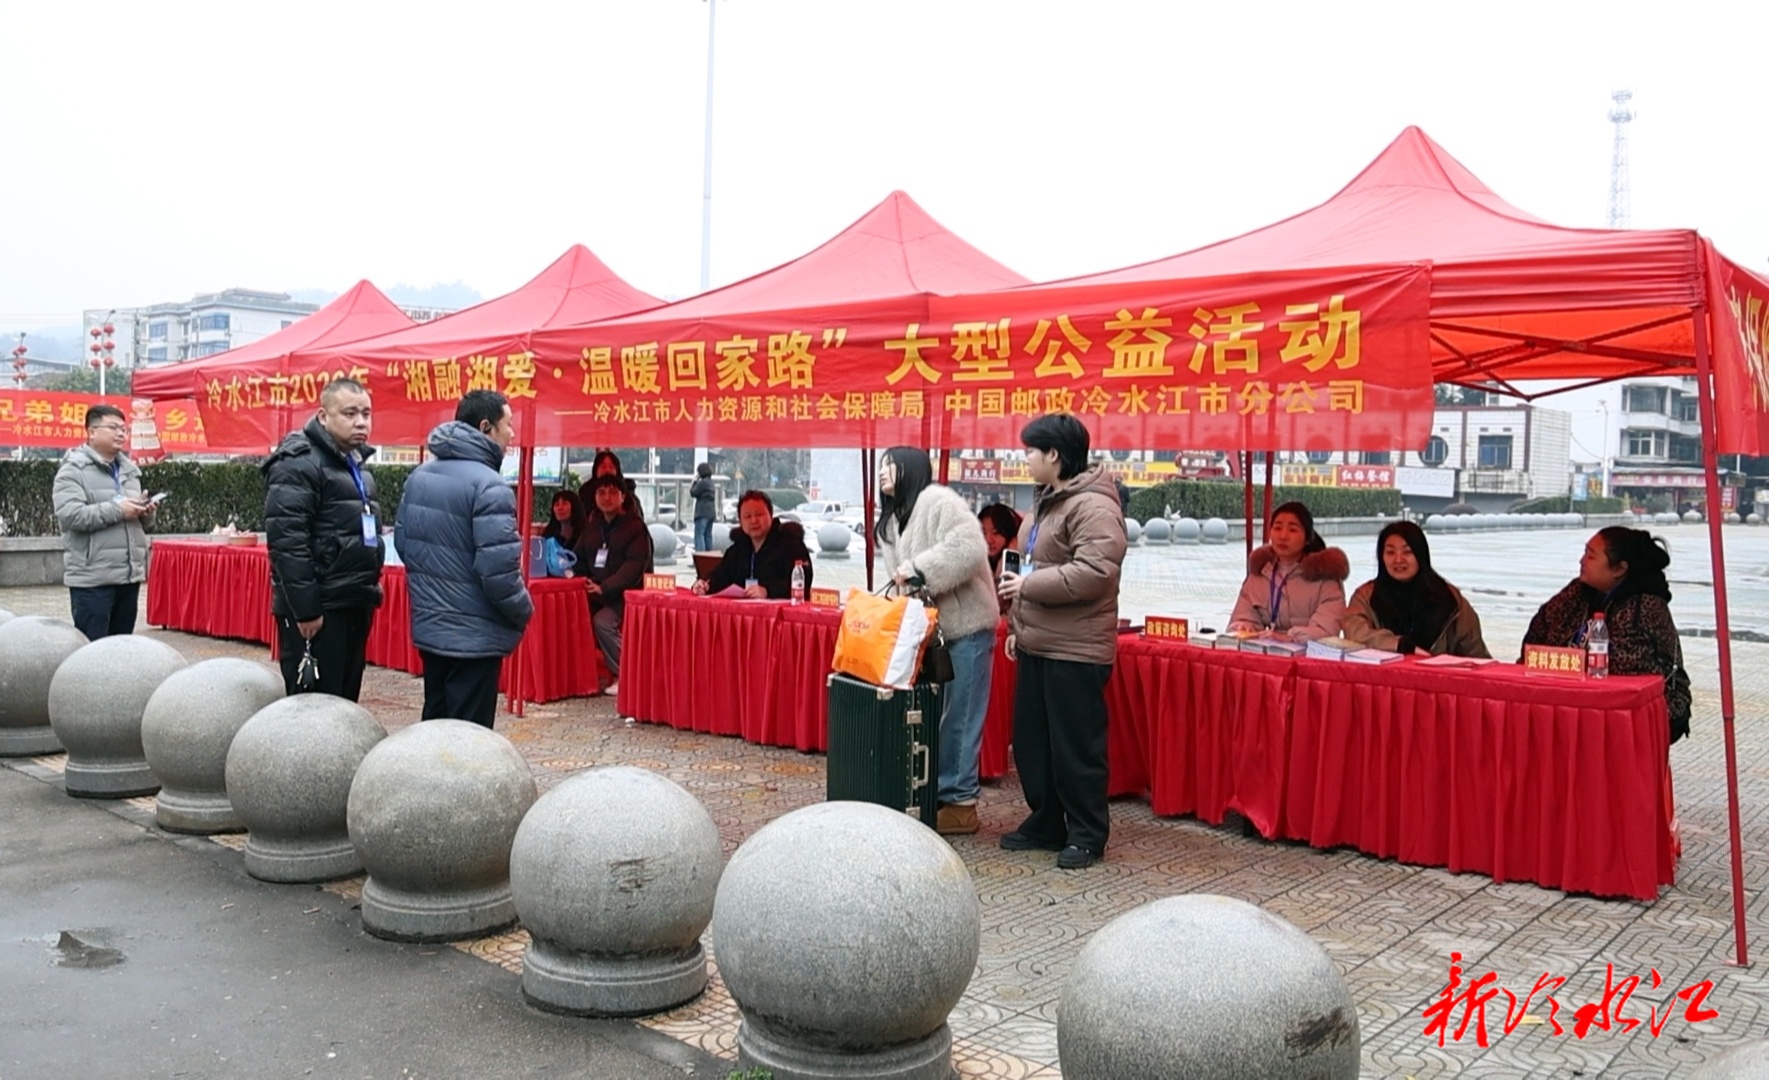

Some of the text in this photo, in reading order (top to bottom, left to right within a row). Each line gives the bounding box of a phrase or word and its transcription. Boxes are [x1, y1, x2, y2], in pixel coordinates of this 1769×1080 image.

[944, 380, 1364, 418] 中国邮政冷水江市分公司
[1527, 649, 1581, 672] 资料发放处
